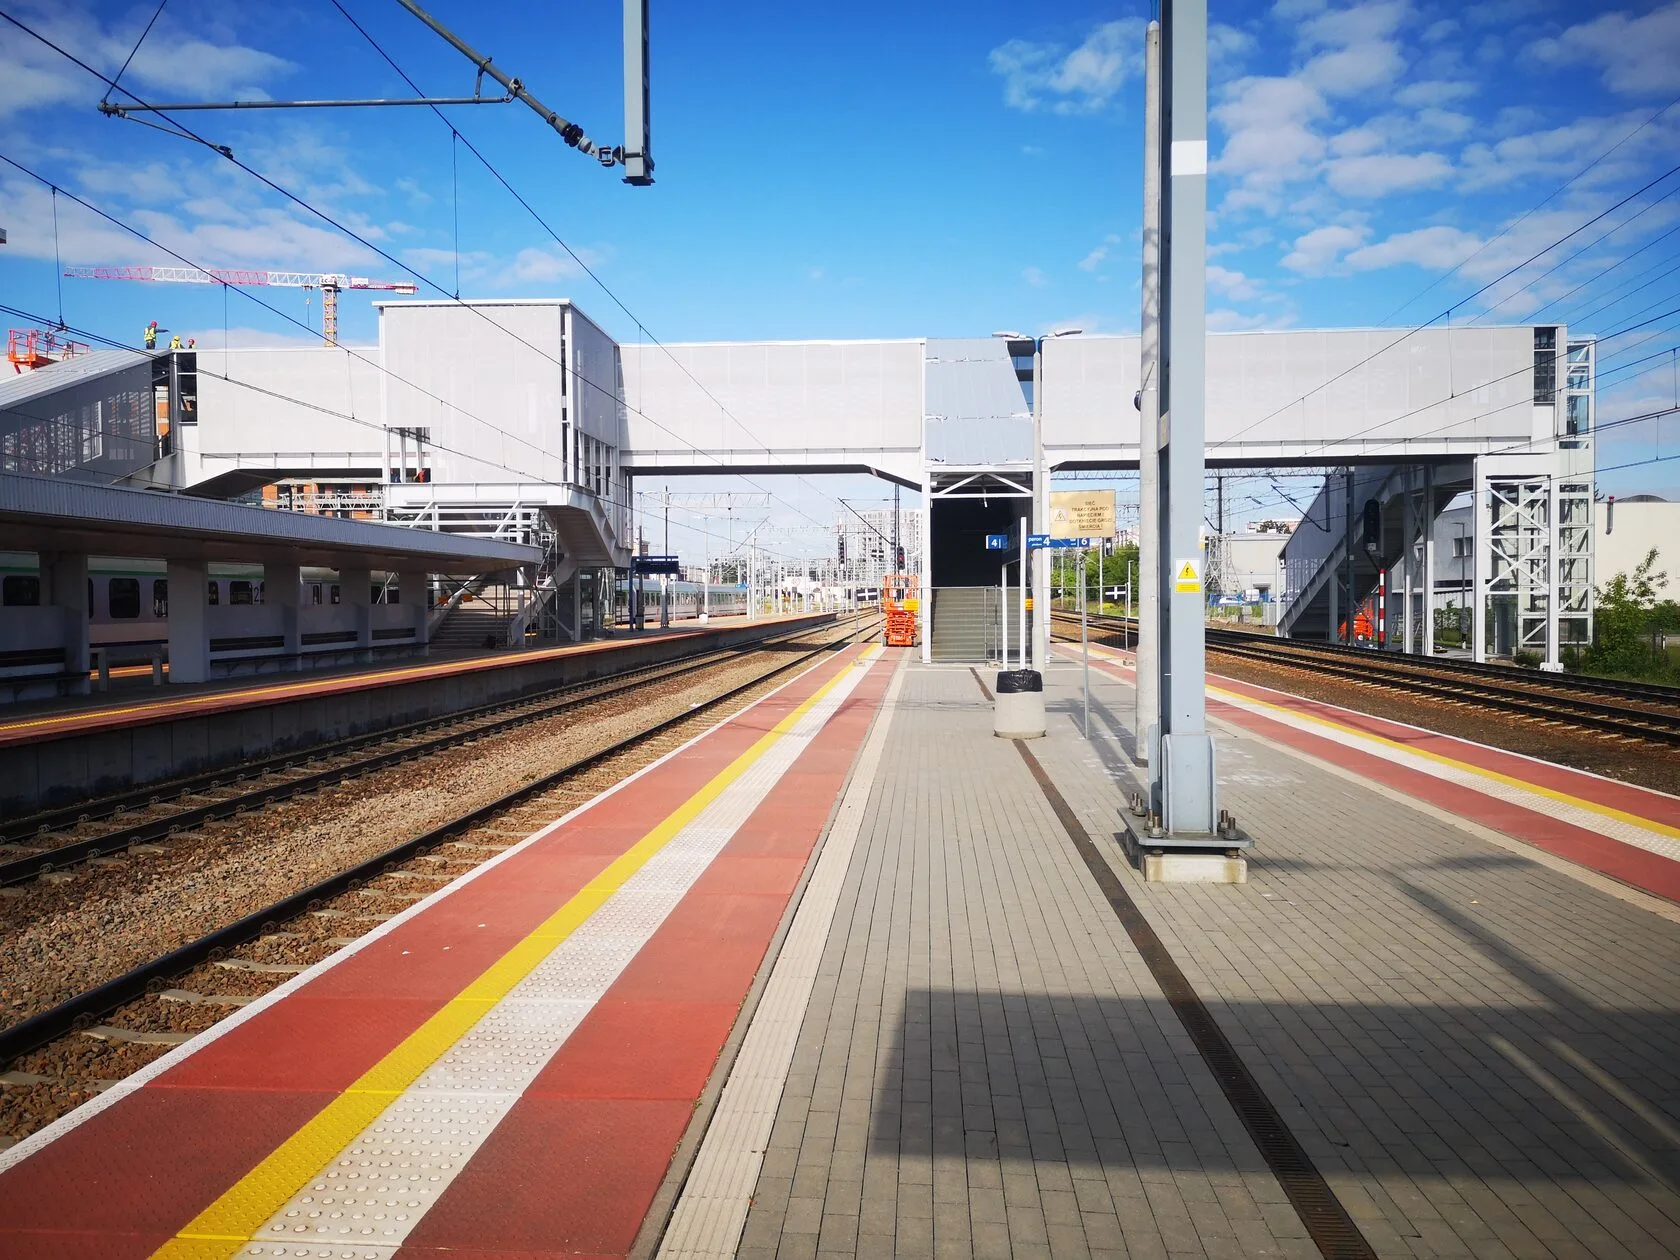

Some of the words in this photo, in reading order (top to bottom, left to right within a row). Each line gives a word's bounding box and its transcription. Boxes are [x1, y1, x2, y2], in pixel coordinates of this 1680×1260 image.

[991, 538, 998, 547] 4
[1043, 536, 1050, 546] 4
[1081, 537, 1088, 546] 6
[254, 586, 260, 602] 2
